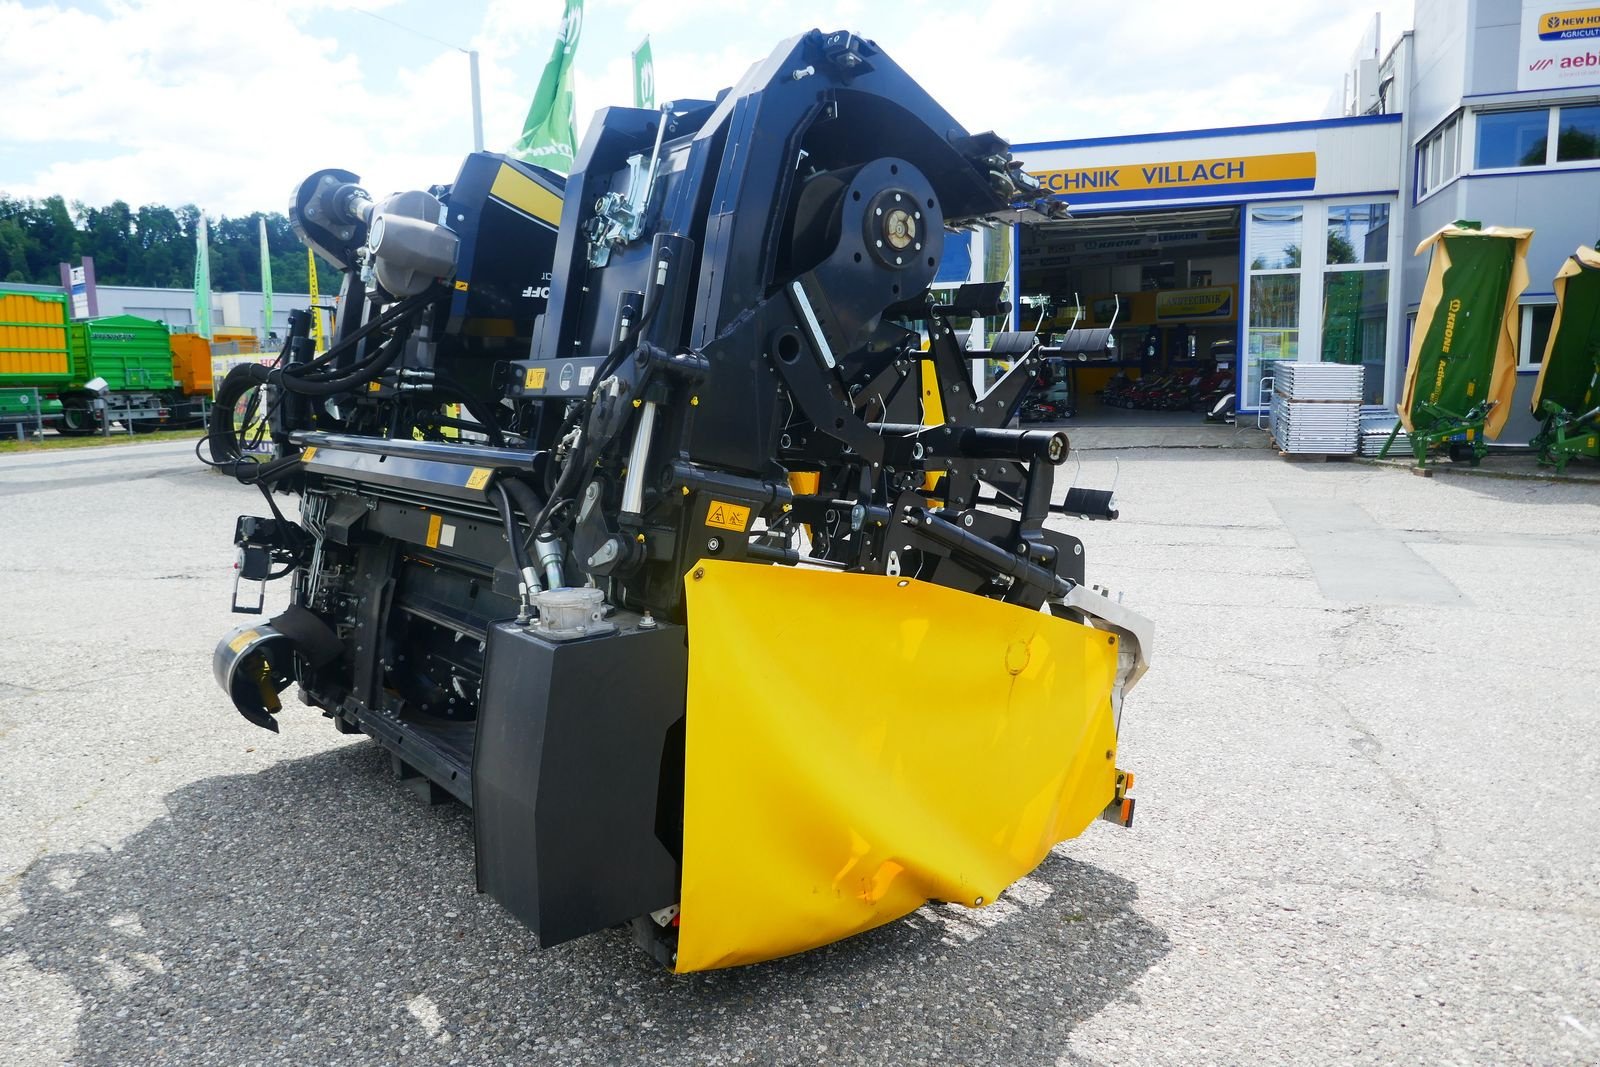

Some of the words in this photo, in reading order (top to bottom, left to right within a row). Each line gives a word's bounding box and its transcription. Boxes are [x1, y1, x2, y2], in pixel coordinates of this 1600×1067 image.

[1562, 17, 1584, 26] NEW
[1561, 29, 1600, 38] AGRICULT
[1142, 161, 1244, 185] VILLACH
[1098, 238, 1142, 249] KRONE
[1442, 312, 1456, 353] KRONE
